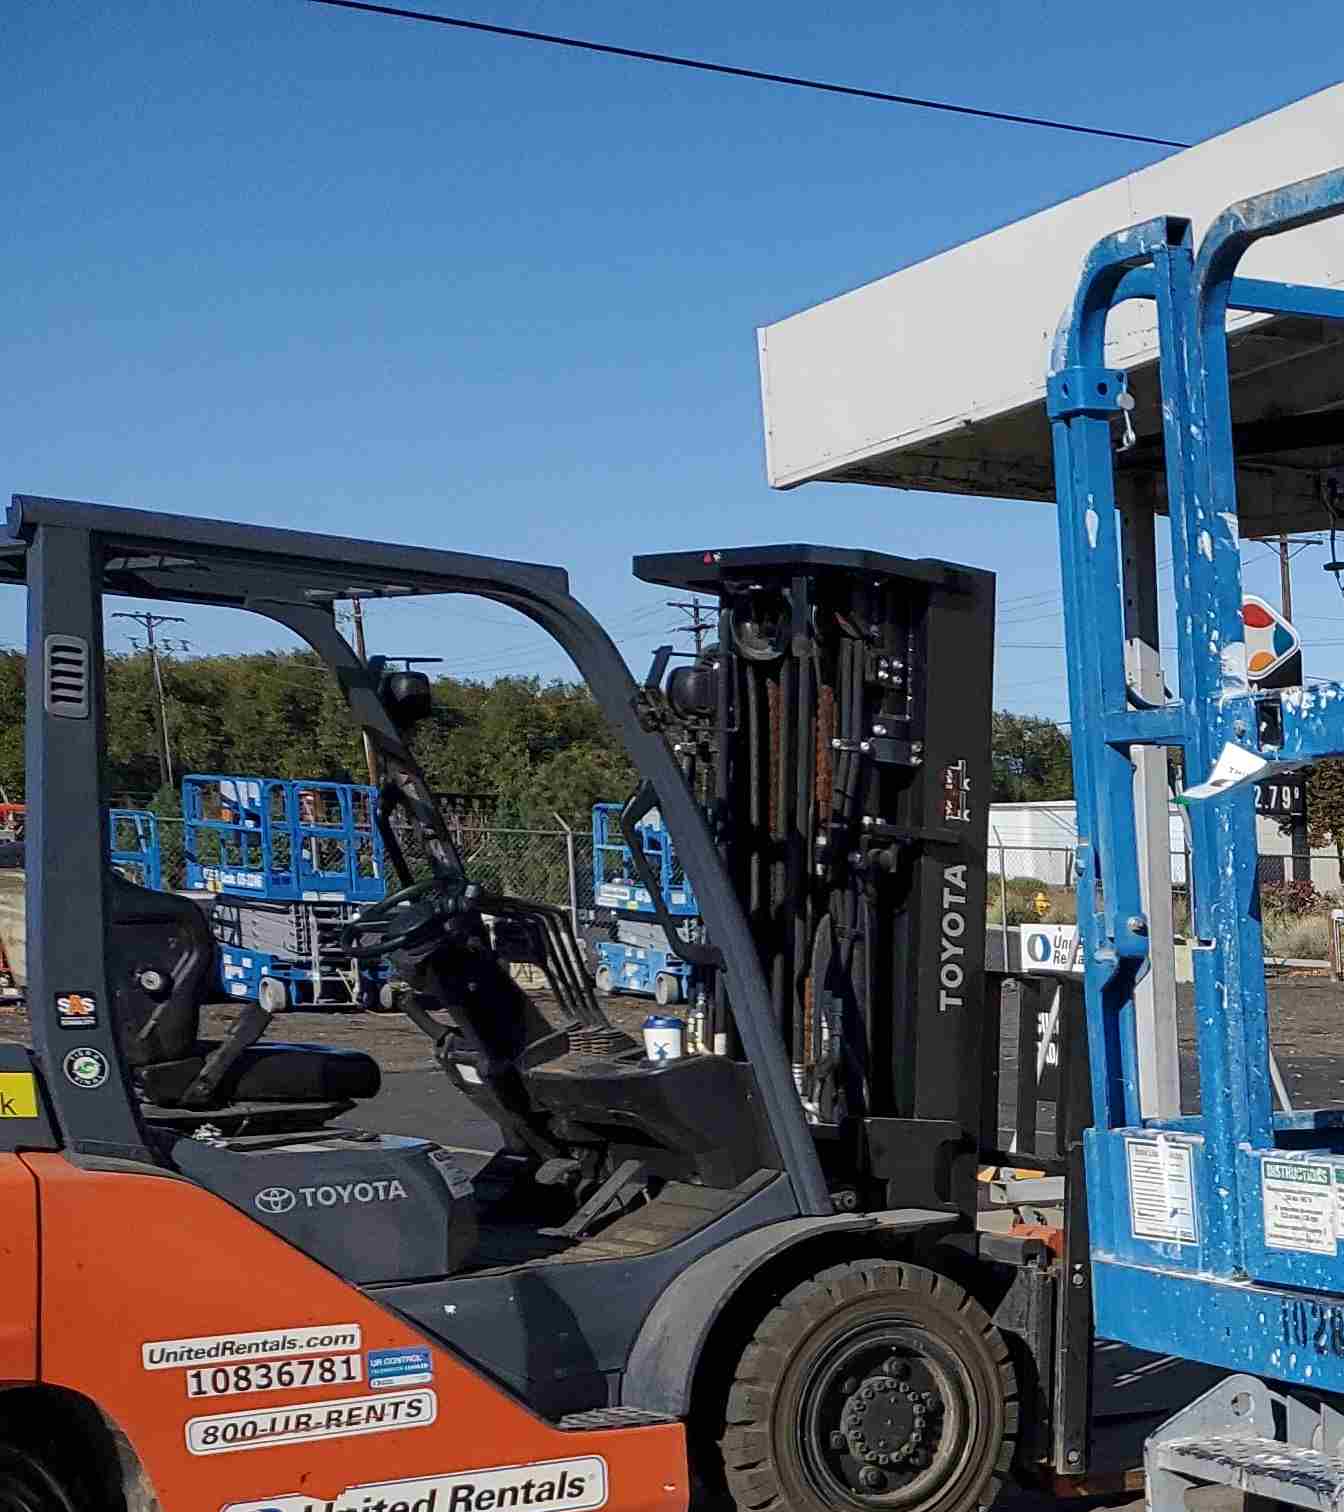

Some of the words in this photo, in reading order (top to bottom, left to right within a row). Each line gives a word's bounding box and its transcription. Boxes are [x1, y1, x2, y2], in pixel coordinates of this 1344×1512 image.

[939, 864, 967, 1012] TOYOTA
[300, 1178, 408, 1208] TOYOTA
[149, 1331, 356, 1365] UnitedRentals.com
[190, 1356, 358, 1396] 10836781
[201, 1398, 424, 1446] 800-UR-RENTS
